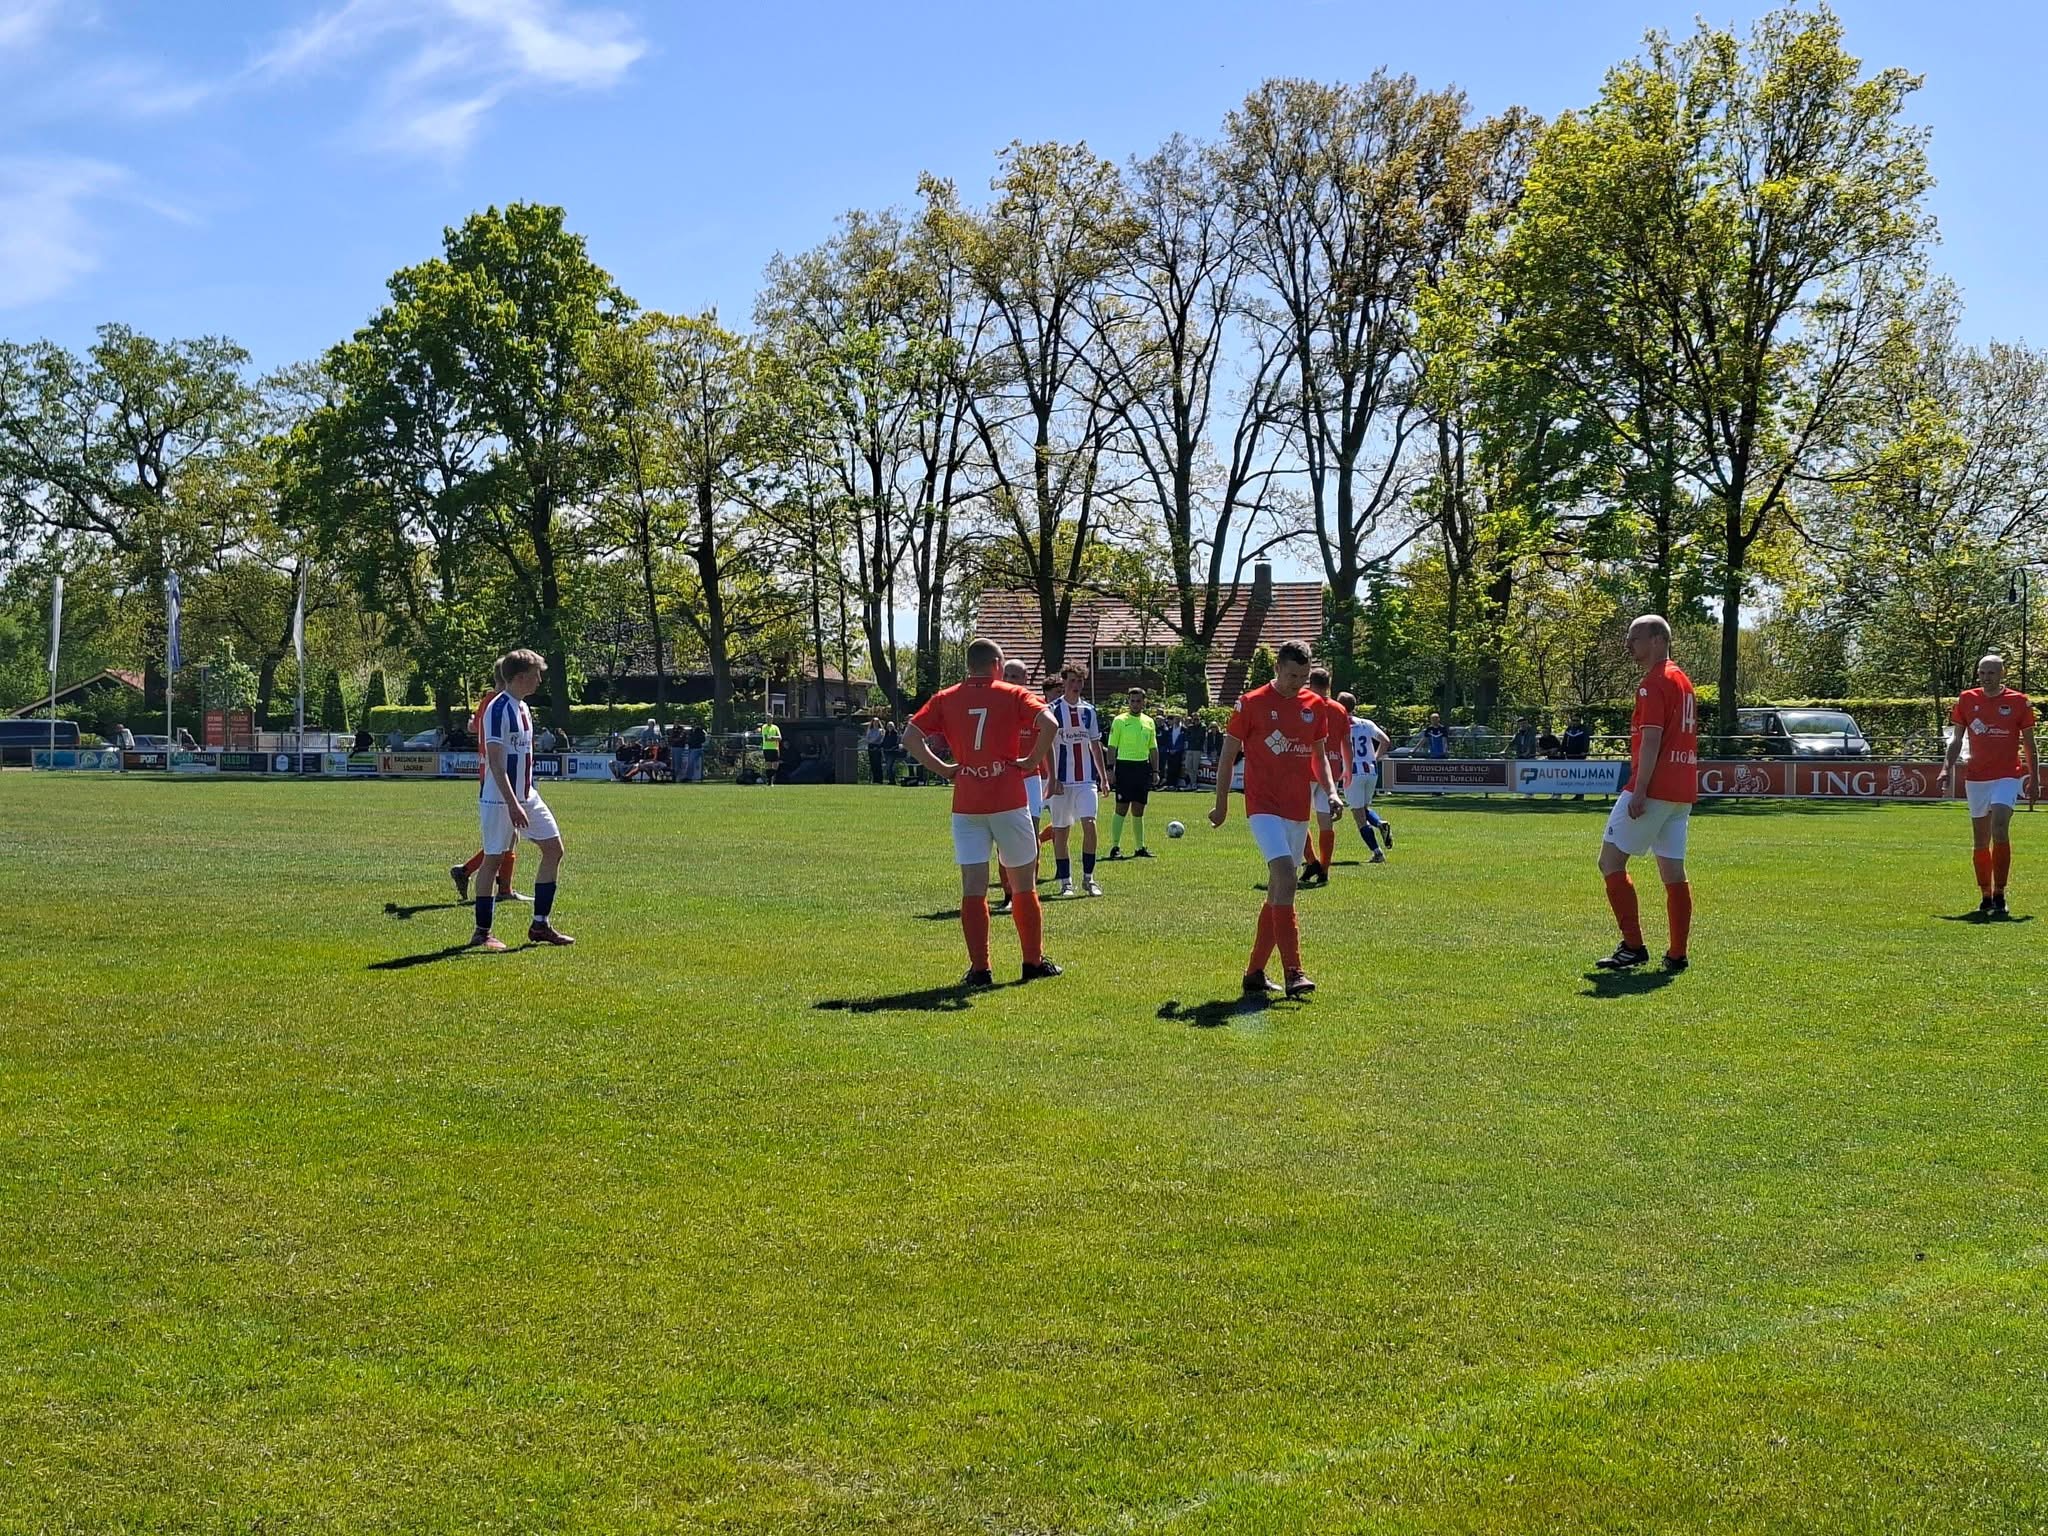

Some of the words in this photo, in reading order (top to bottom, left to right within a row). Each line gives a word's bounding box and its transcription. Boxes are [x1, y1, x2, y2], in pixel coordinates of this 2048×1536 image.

[968, 708, 988, 751] 7
[535, 760, 558, 776] amp
[960, 766, 989, 778] ING
[1538, 767, 1615, 779] AUTONIJMAN
[1810, 769, 1877, 796] ING
